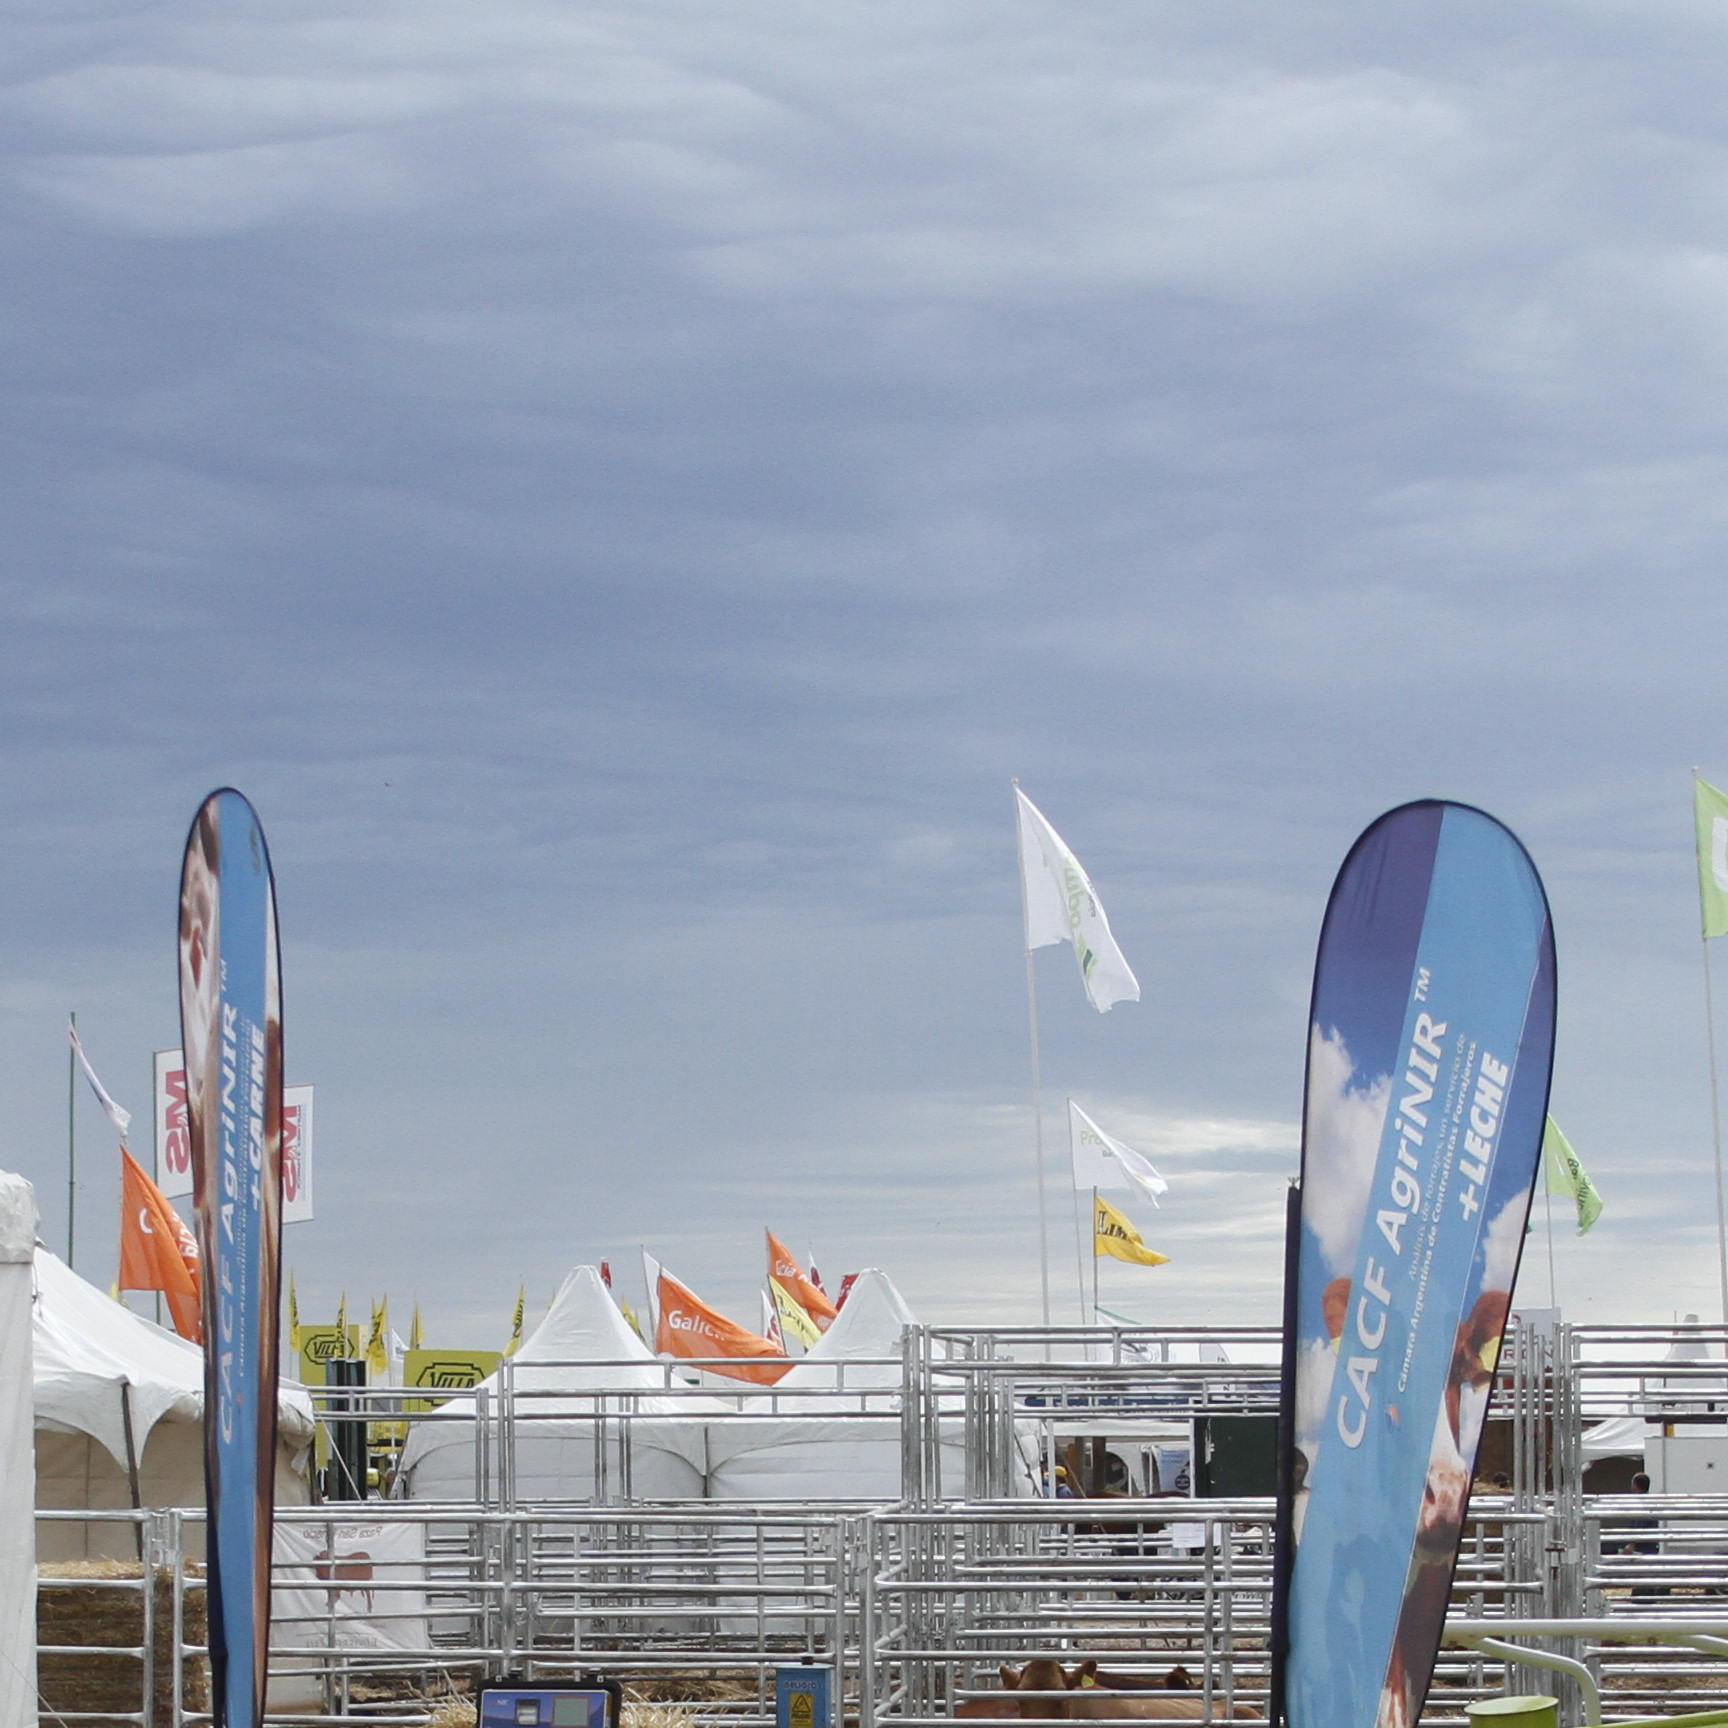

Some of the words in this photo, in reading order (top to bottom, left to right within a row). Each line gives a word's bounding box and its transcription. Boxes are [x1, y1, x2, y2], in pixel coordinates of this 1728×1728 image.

[221, 1003, 239, 1245] AgriNIR
[1452, 1041, 1477, 1124] Forrajeros
[1432, 1125, 1458, 1223] Contratistas
[1336, 1256, 1393, 1449] CACF
[1375, 1011, 1448, 1257] AgriNIR
[1428, 1228, 1438, 1248] de
[1411, 1252, 1434, 1331] Argentina
[218, 1253, 234, 1445] CACF
[1398, 1335, 1418, 1393] Cámara
